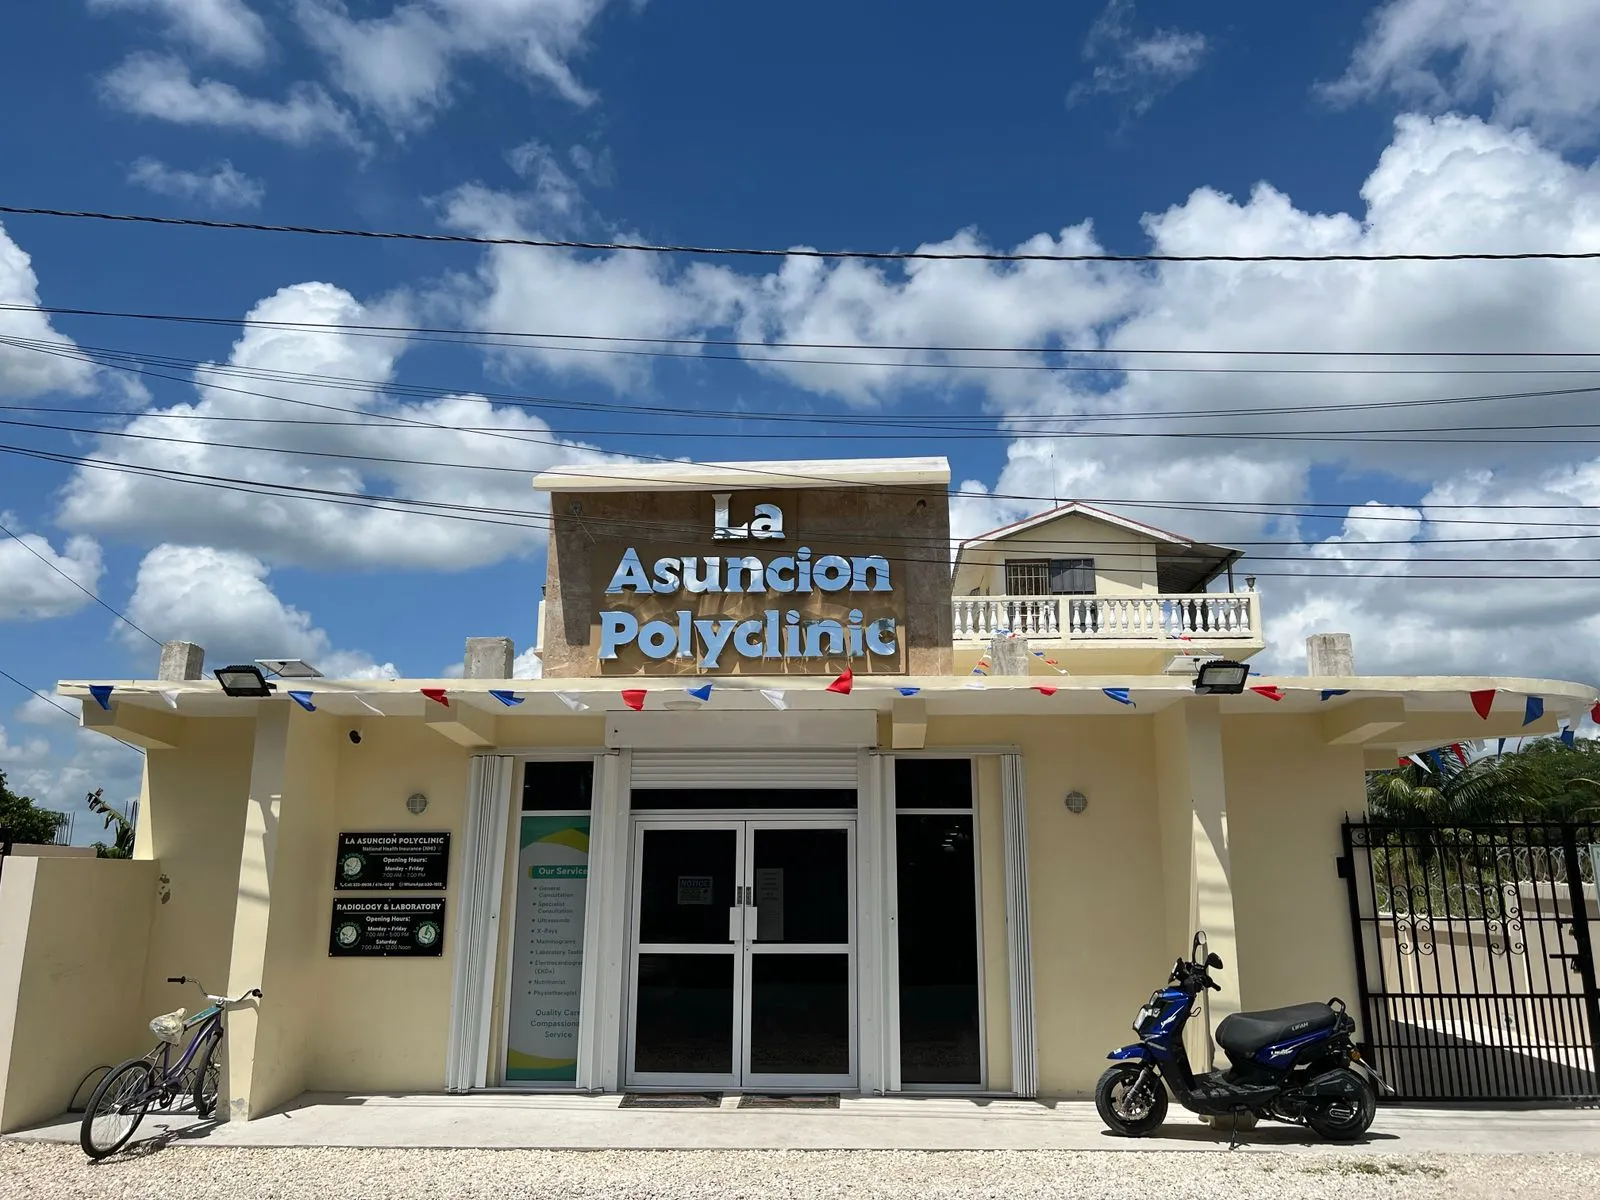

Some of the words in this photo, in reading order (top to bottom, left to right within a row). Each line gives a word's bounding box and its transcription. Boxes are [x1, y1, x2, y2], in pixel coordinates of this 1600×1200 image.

[711, 493, 786, 540] La
[604, 546, 893, 594] Asuncion
[599, 608, 896, 669] Polyclinic
[345, 837, 355, 845] LA
[357, 837, 397, 845] ASUNCION
[538, 867, 555, 875] Our
[544, 1030, 573, 1038] Service
